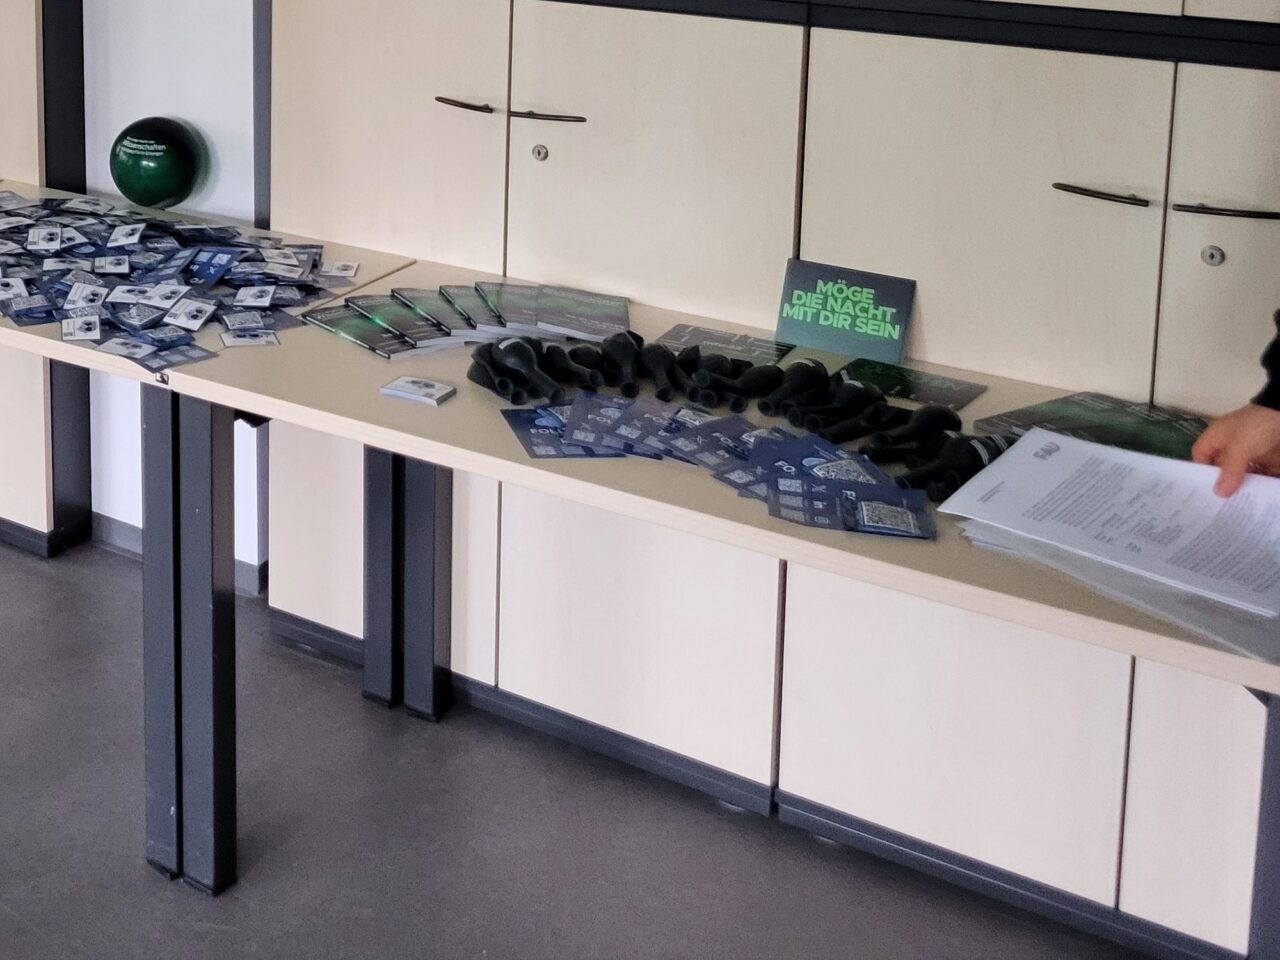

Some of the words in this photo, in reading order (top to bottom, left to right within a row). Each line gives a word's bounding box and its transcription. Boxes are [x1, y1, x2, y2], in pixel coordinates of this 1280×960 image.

[815, 279, 875, 304] MÖGE
[792, 290, 824, 309] DIE
[826, 296, 897, 323] NACHT
[782, 303, 817, 322] MIT
[819, 311, 850, 330] DIR
[854, 317, 901, 340] SEIN
[1032, 441, 1060, 460] FAU
